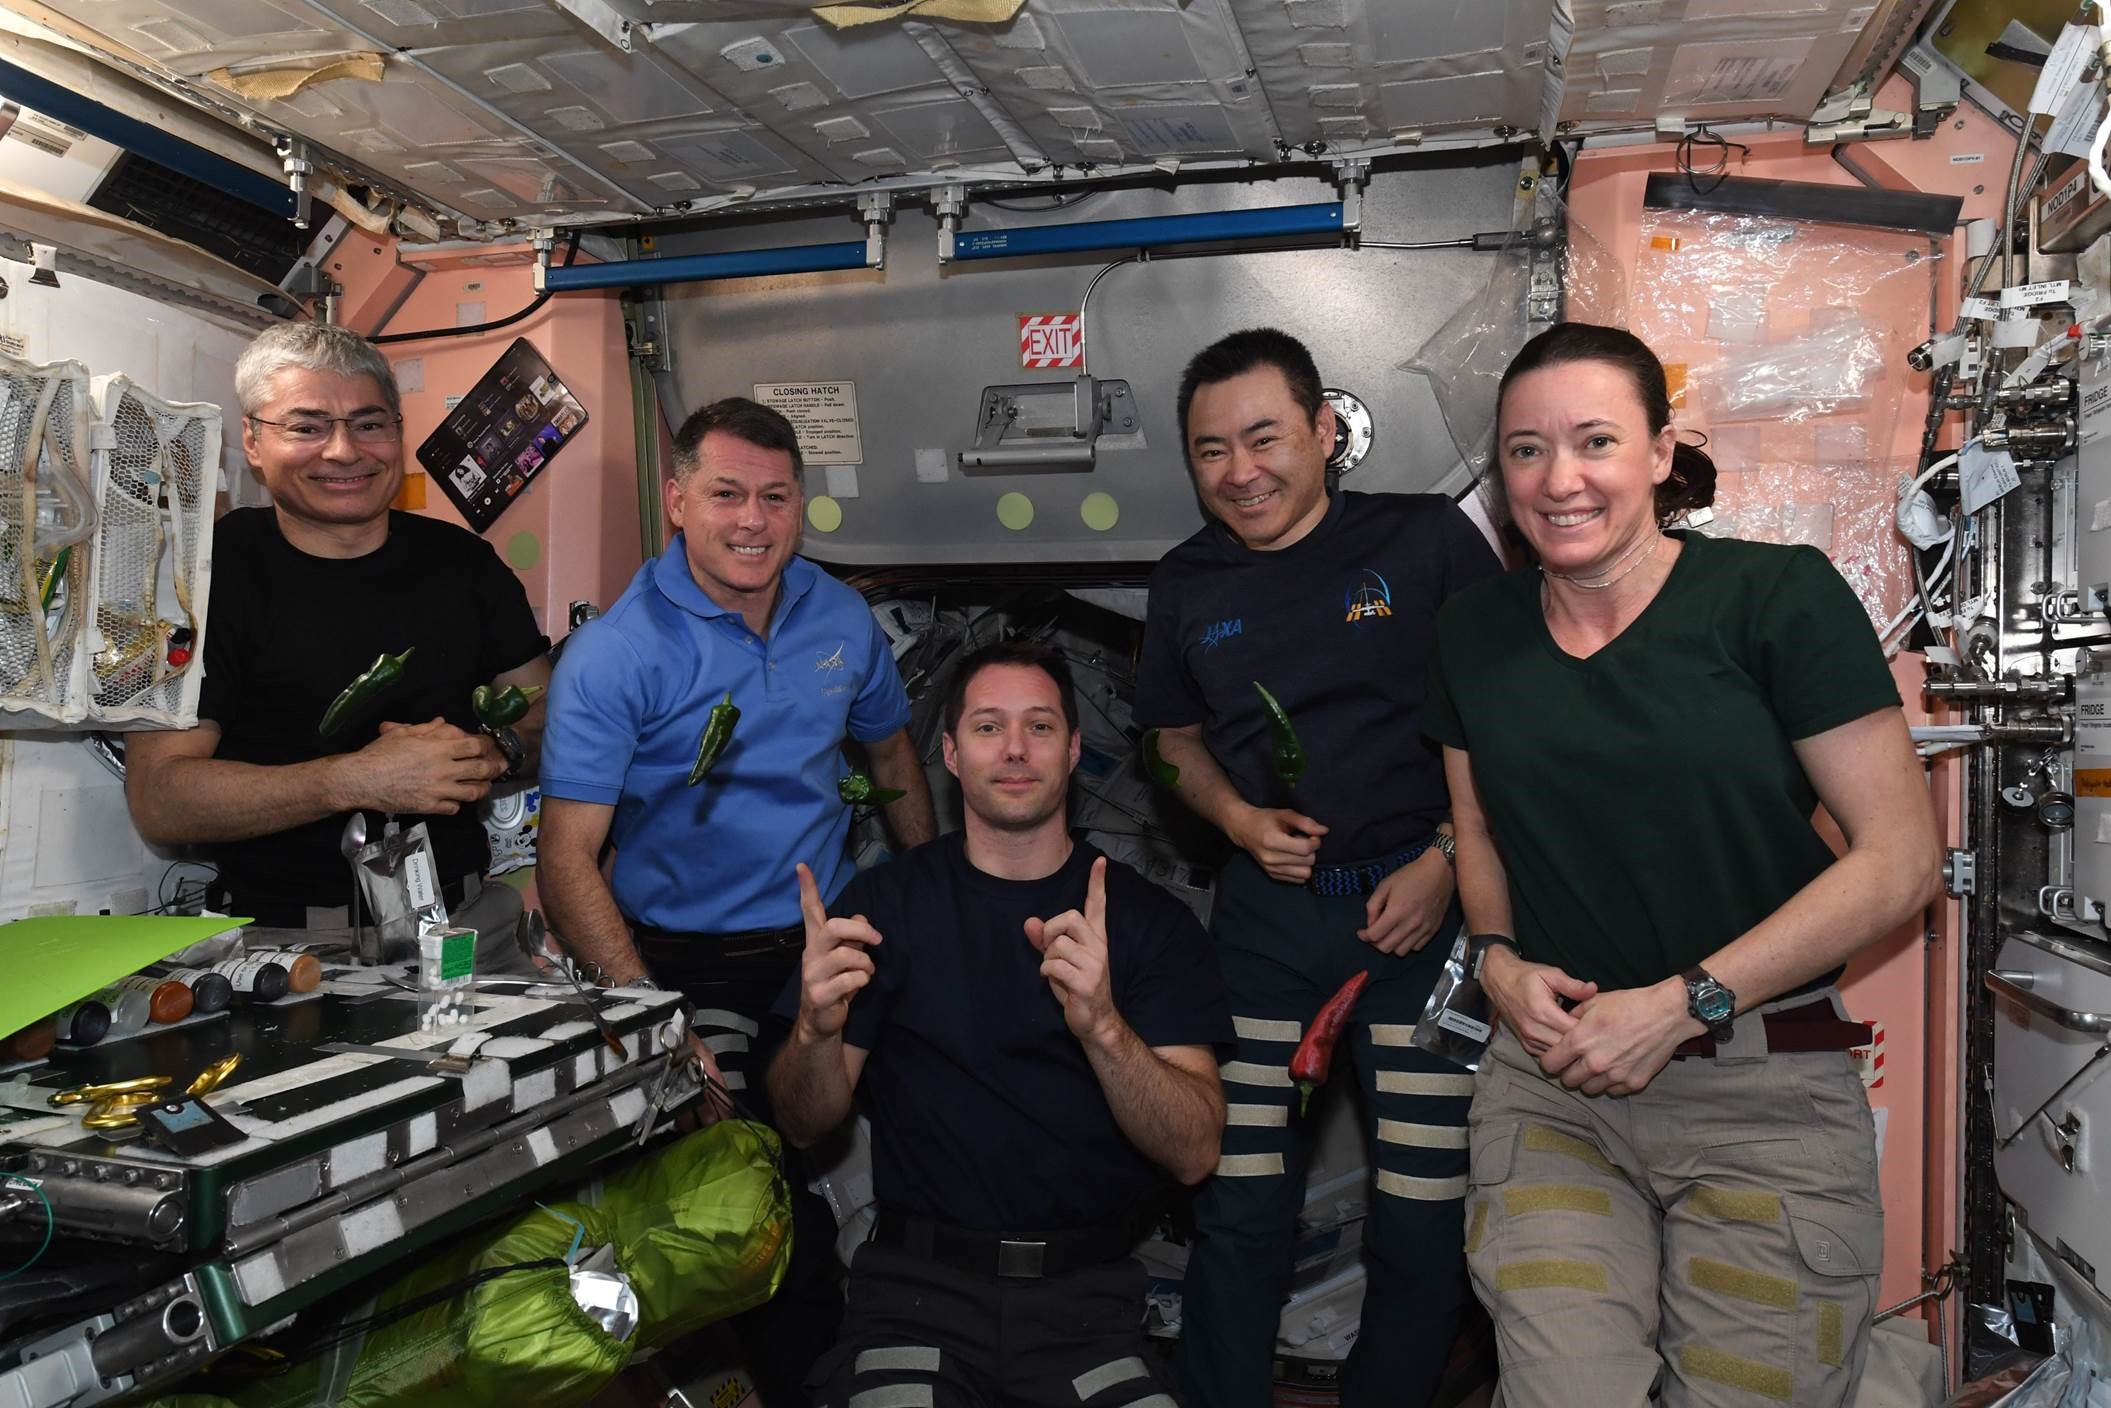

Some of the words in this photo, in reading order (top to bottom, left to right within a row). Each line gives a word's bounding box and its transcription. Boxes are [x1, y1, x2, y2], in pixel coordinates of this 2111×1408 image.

[2047, 179, 2078, 216] NOD1P4
[1030, 328, 1071, 355] EXIT
[773, 388, 809, 396] CLOSING
[811, 386, 840, 395] HATCH
[2084, 386, 2108, 407] FRIDGE
[2081, 704, 2104, 715] FRIDGE
